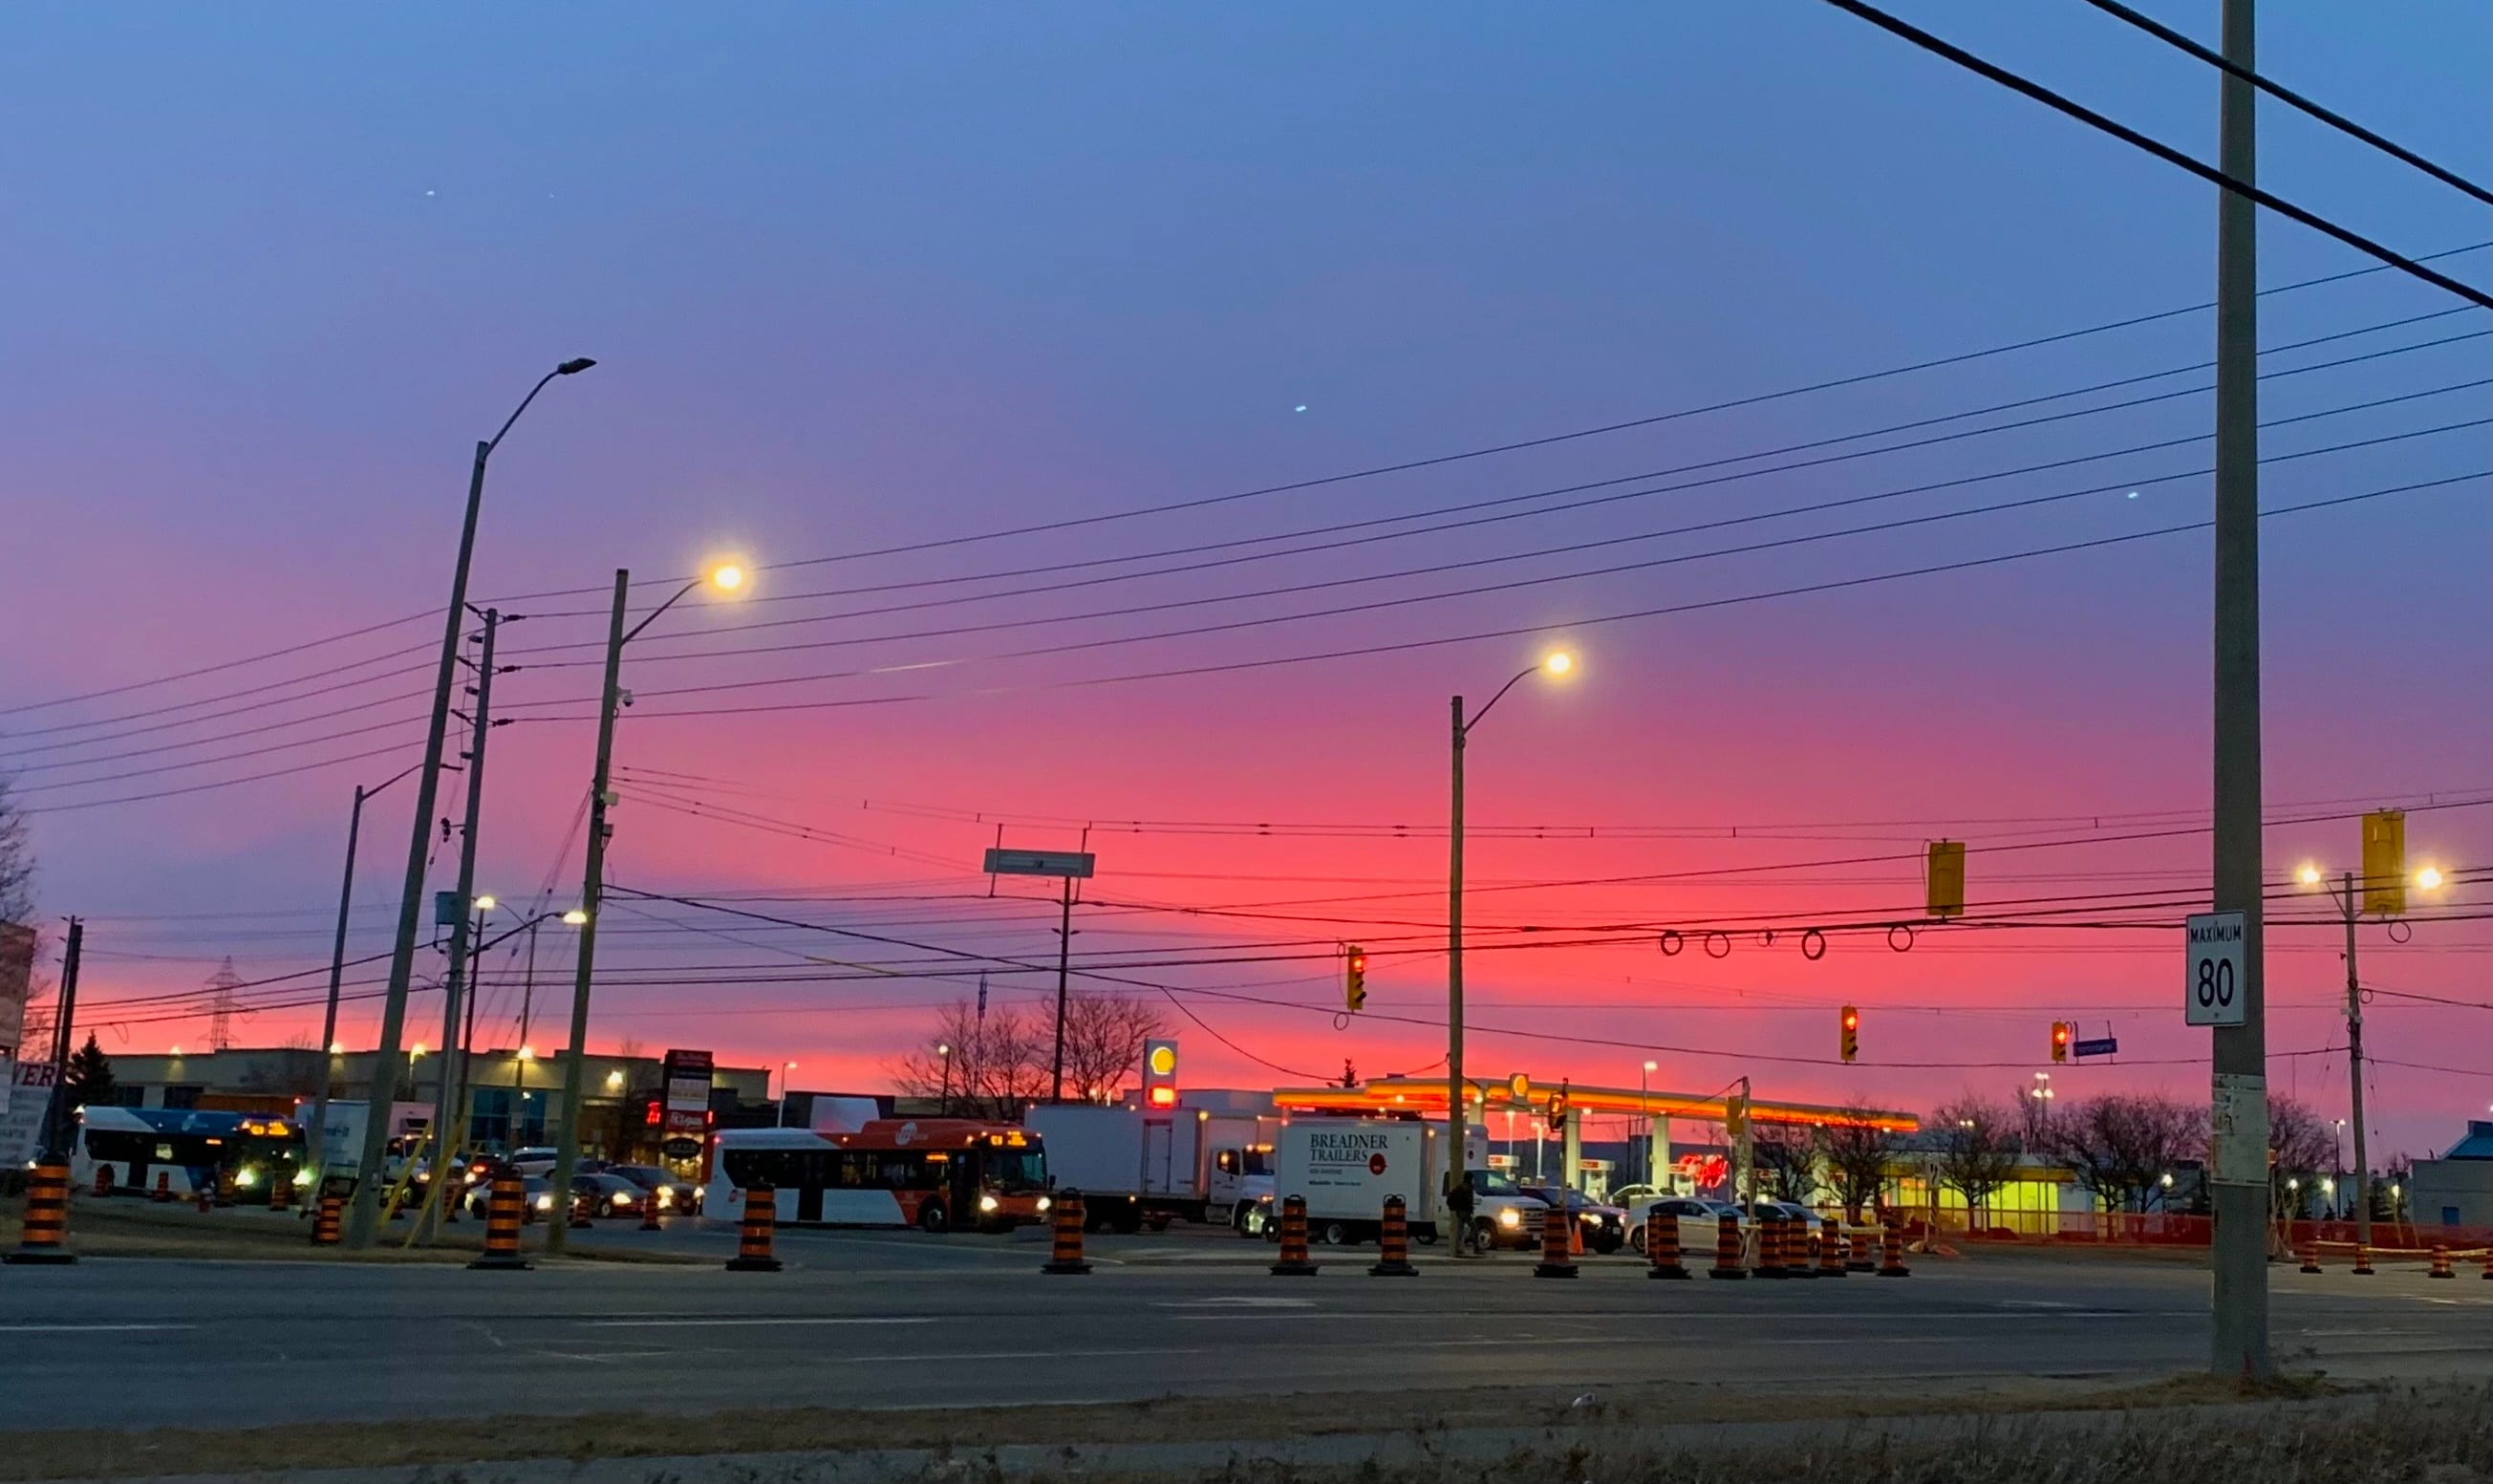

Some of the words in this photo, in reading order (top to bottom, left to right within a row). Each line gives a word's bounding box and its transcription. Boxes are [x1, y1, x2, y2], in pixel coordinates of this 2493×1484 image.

[2190, 925, 2242, 943] MAXIMUM
[2198, 958, 2234, 1007] 80
[1310, 1134, 1388, 1149] BREADNER
[1310, 1150, 1368, 1162] TRAILERS
